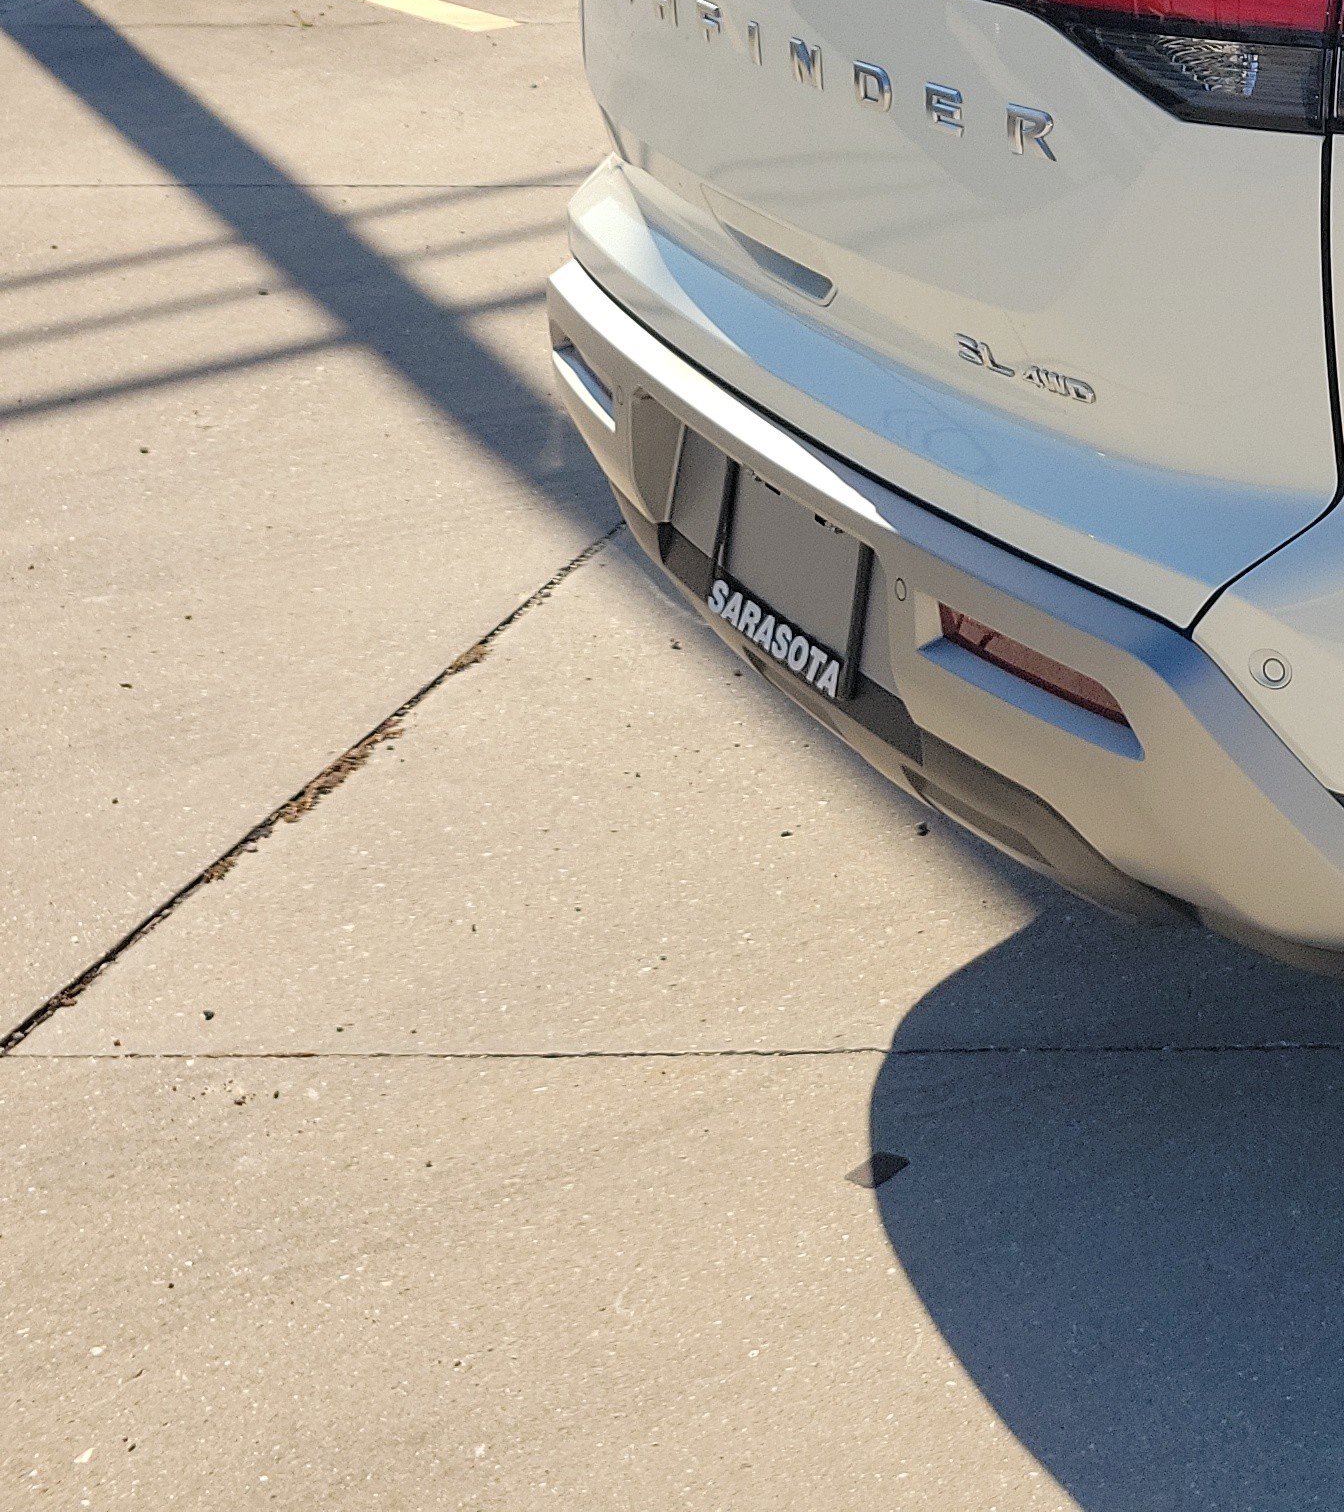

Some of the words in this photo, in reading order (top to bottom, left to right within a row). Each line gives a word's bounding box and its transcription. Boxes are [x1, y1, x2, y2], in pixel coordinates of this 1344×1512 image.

[954, 332, 1016, 378] SL
[1023, 364, 1097, 405] 4WD
[708, 579, 840, 699] SARASOTA
